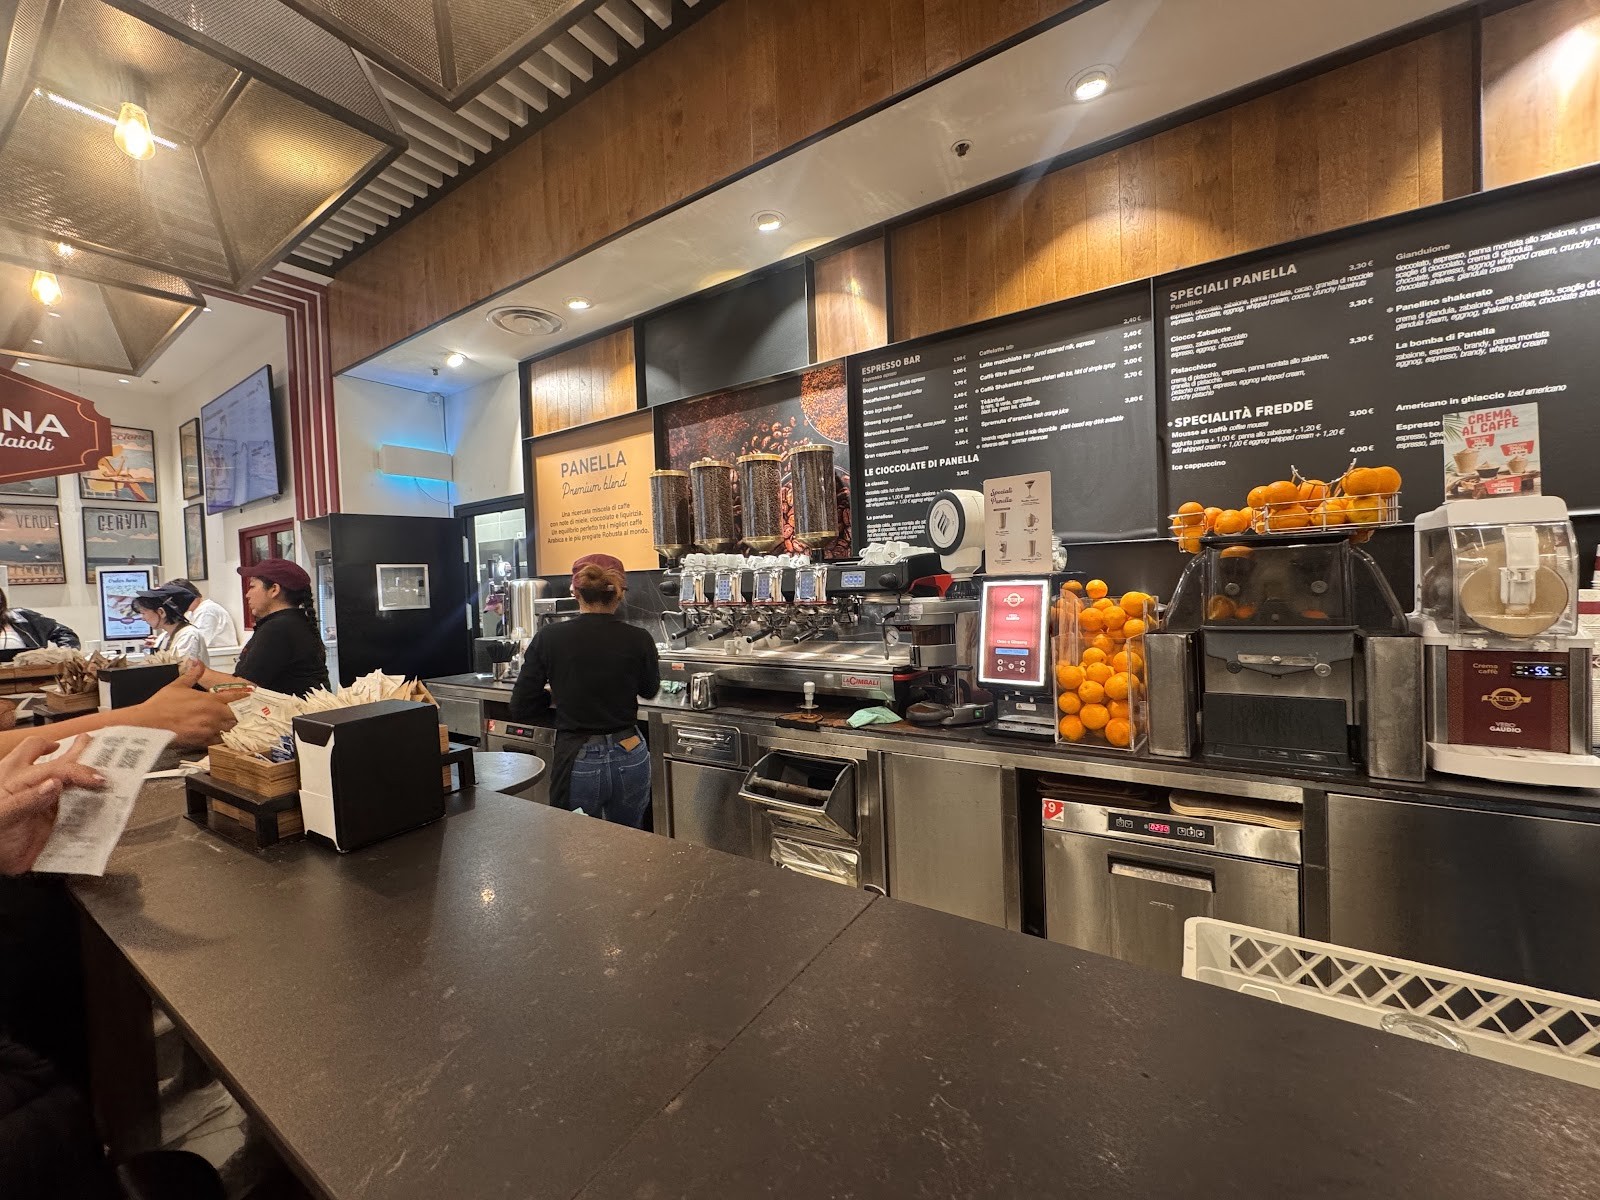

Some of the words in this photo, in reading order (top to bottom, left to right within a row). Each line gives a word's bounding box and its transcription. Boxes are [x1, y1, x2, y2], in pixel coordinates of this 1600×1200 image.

[1468, 246, 1492, 257] panna
[1492, 251, 1499, 259] di
[1170, 279, 1229, 302] SPECIALI
[1233, 263, 1297, 288] PANELLA
[1170, 299, 1203, 311] Panellino
[1396, 298, 1440, 312] Panellino
[1441, 288, 1494, 304] shakerato
[1170, 333, 1196, 343] Ciocco
[1395, 342, 1408, 350] La
[1409, 336, 1444, 348] bomba
[1445, 333, 1455, 341] di
[1457, 327, 1496, 340] Panella
[1492, 336, 1516, 346] panna
[1522, 338, 1548, 348] cream
[861, 359, 902, 375] ESPRESSO
[903, 354, 921, 366] BAR
[1170, 362, 1217, 375] Pistacchioso
[1395, 399, 1448, 412] Americano
[1460, 392, 1505, 405] ghiaccio
[1507, 388, 1525, 398] iced
[1525, 383, 1567, 396] americano
[1174, 406, 1252, 428] SPECIALITÀ
[1255, 400, 1314, 417] FREDDE
[1468, 408, 1512, 425] CREMA
[1171, 430, 1199, 439] Mousse
[1208, 425, 1228, 433] caffè
[1395, 421, 1440, 431] Espresso
[1462, 425, 1477, 436] AL
[1480, 415, 1519, 433] CAFFÈ
[561, 450, 627, 478] PANELLA
[864, 468, 874, 477] LE
[875, 461, 927, 475] CIOCCOLATE
[928, 459, 938, 468] DI
[939, 453, 980, 467] PANELLA
[1184, 460, 1226, 470] cappuccino
[562, 482, 602, 499] Premium
[603, 472, 628, 490] blend
[16, 514, 55, 529] VERDE
[97, 513, 147, 531] CERVIA
[589, 513, 615, 523] cioccolato
[609, 520, 629, 529] migliori
[602, 530, 623, 538] Robusta
[1489, 725, 1522, 733] GAUDIO
[1047, 802, 1056, 813] 9
